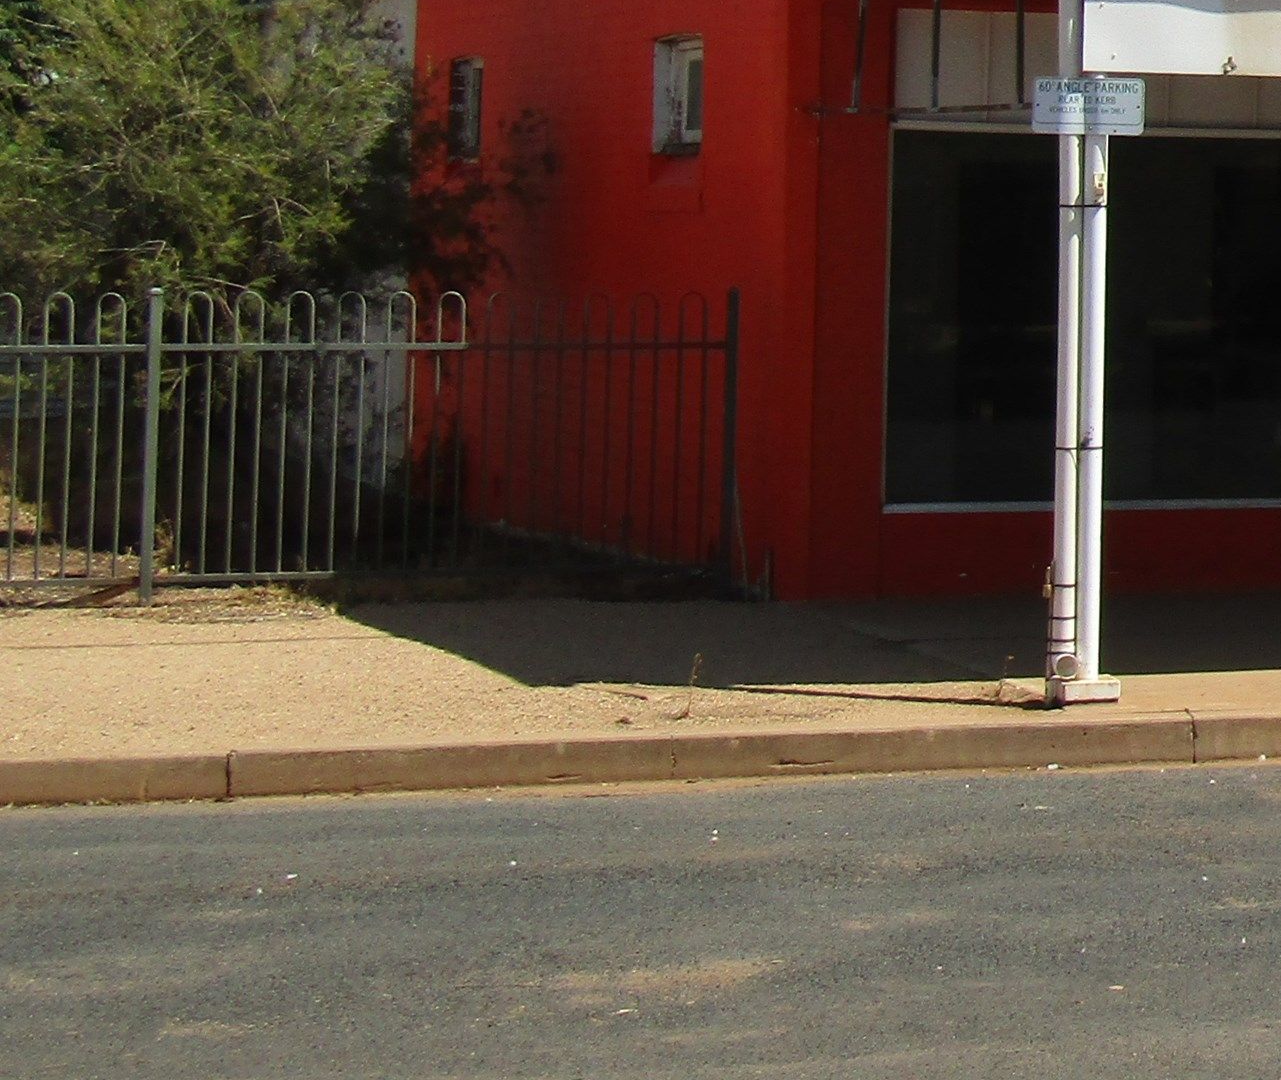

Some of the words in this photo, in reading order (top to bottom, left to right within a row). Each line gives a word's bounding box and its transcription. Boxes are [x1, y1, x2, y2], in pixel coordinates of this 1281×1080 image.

[1056, 81, 1091, 94] ANGLE
[1094, 82, 1139, 94] PARKING
[1058, 95, 1080, 104] REAR
[1095, 96, 1117, 105] KERB
